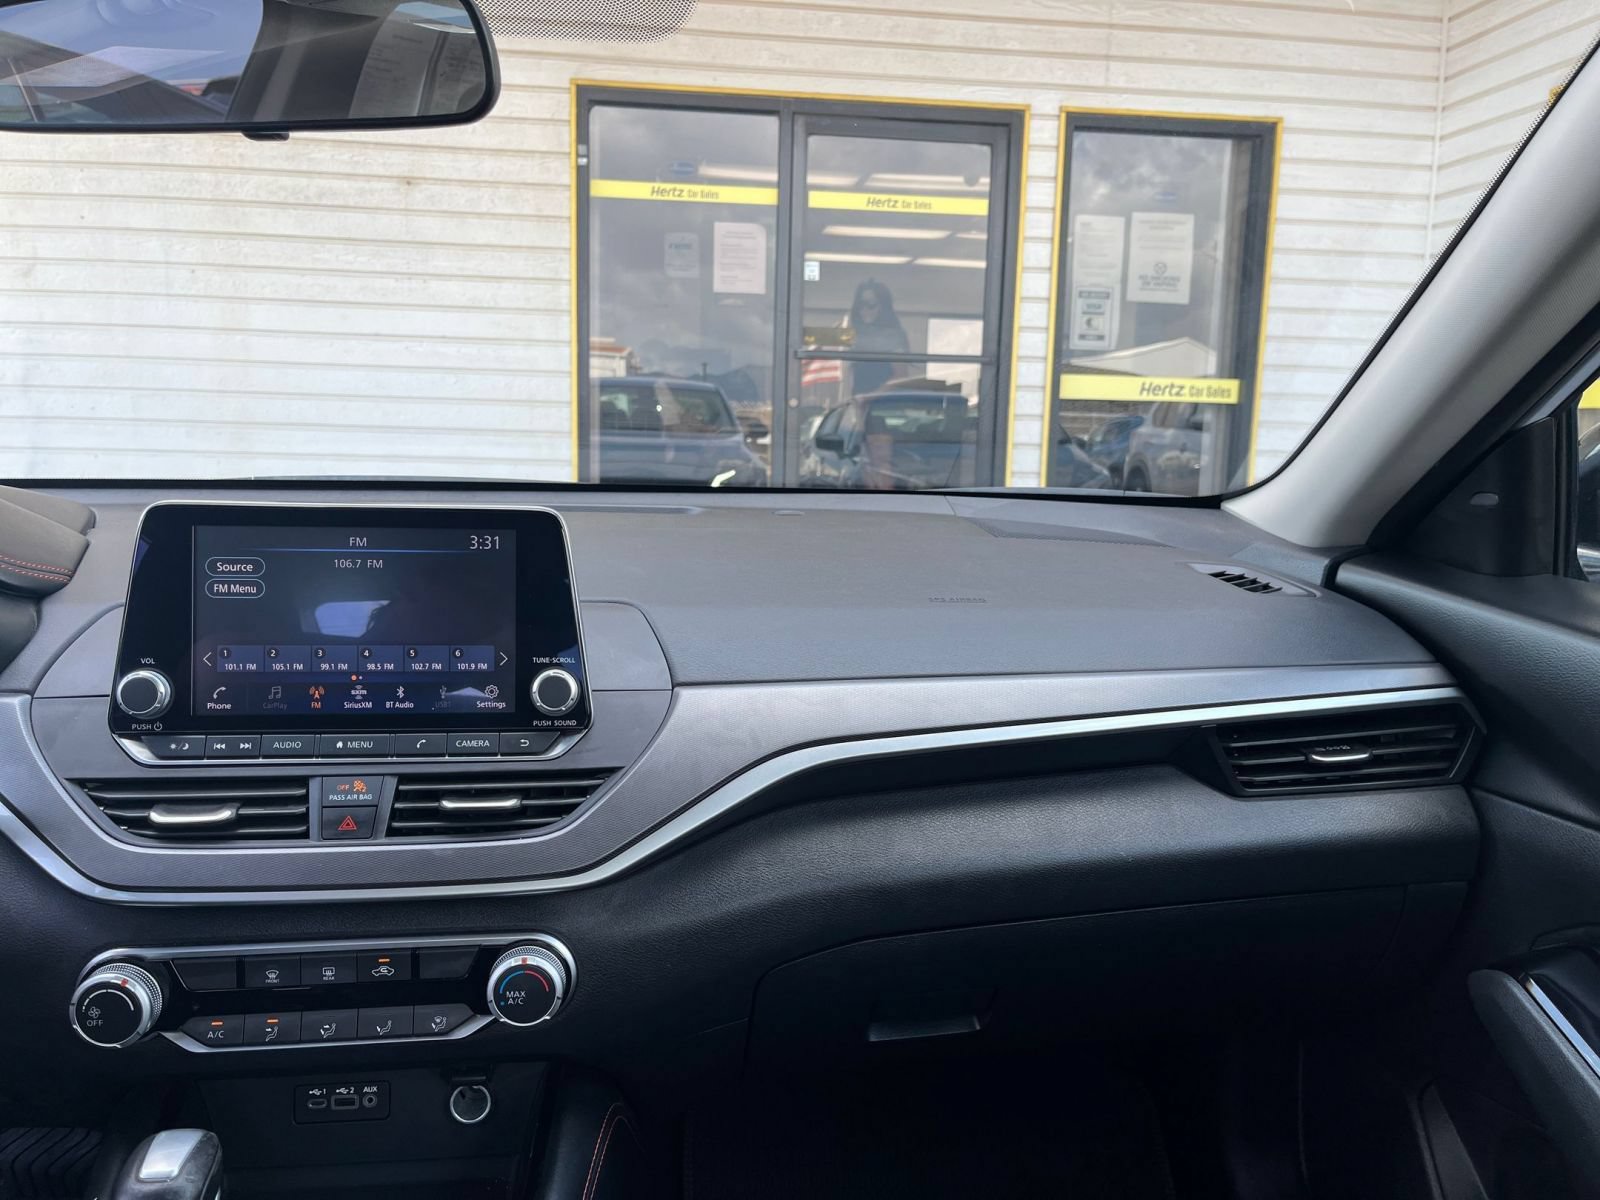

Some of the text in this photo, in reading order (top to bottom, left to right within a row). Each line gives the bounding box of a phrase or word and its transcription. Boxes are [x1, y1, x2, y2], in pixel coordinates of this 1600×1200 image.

[651, 185, 685, 198] Hertz
[866, 196, 899, 209] Hertz
[1140, 381, 1232, 399] Hertz Car Sales
[349, 537, 367, 547] FM
[469, 535, 500, 550] 3:31
[217, 562, 254, 572] Source
[334, 559, 383, 569] 106.7 FM
[213, 584, 257, 593] FM Menu
[207, 702, 232, 710] Phone
[263, 702, 288, 711] CarPlay
[344, 701, 372, 709] SiriusXM
[476, 701, 506, 709] Settings
[273, 741, 301, 749] AUDIO
[207, 1030, 224, 1039] A/C
